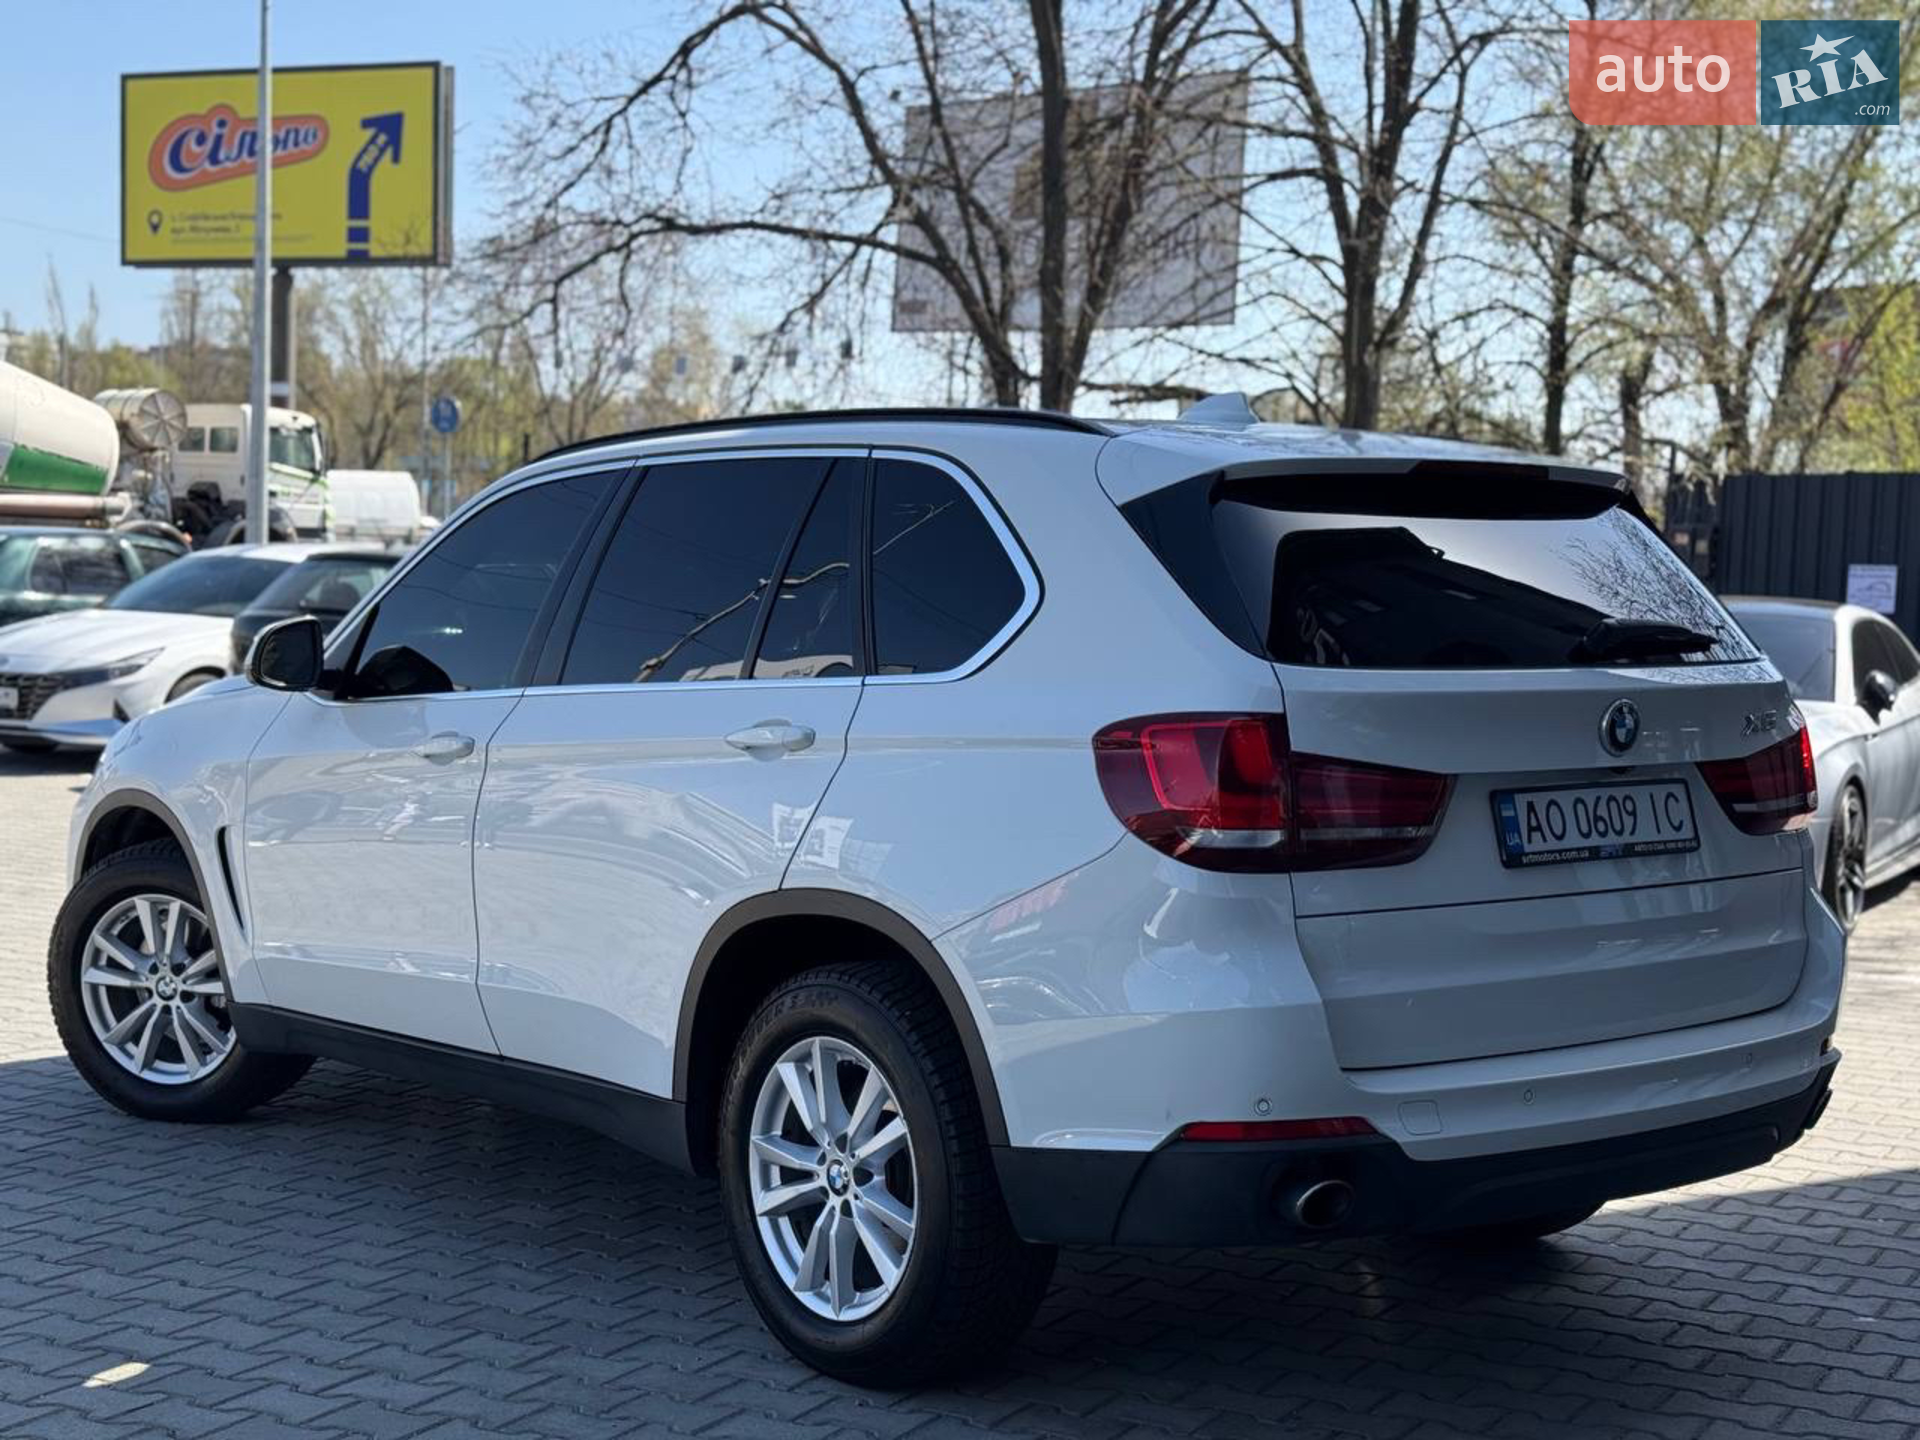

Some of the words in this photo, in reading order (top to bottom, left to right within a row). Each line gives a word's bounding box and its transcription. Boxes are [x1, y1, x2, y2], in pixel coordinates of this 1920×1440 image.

[1525, 798, 1567, 844] AO
[1573, 794, 1638, 840] 0609
[1649, 791, 1684, 835] IC
